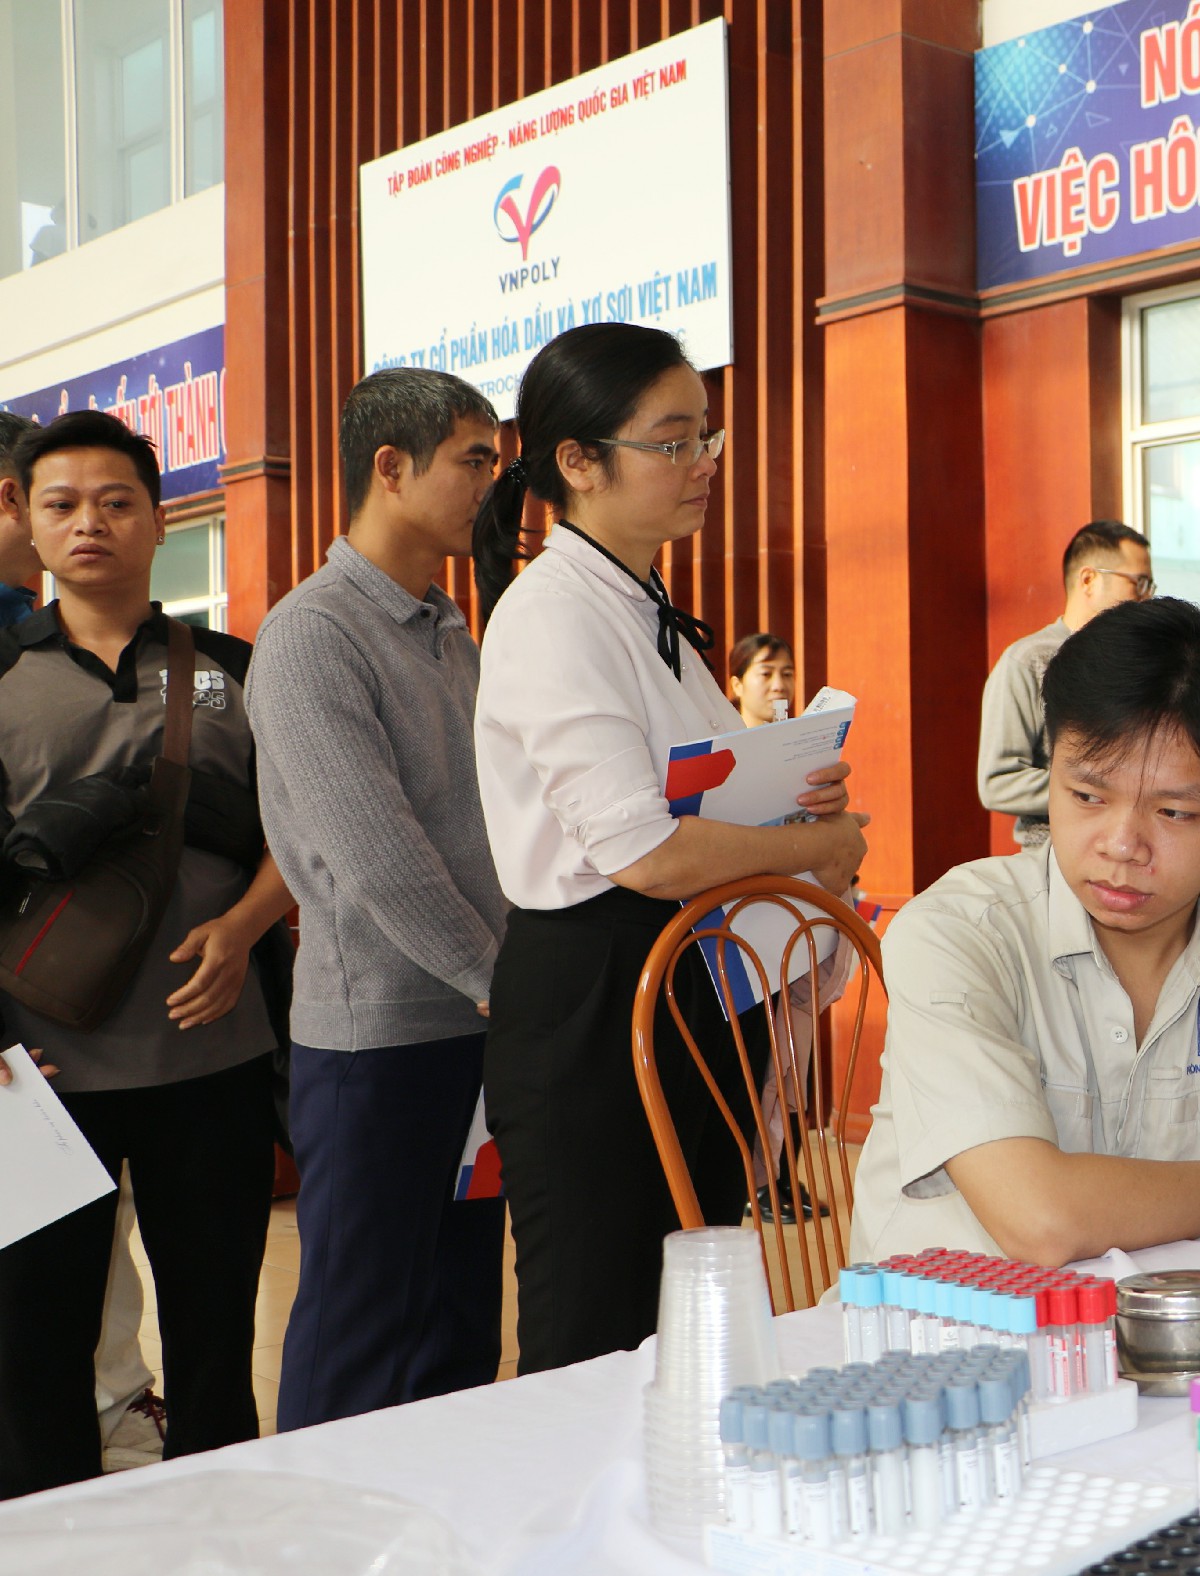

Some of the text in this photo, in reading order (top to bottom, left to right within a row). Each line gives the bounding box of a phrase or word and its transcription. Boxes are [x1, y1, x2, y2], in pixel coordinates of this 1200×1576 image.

[435, 151, 461, 177] CÔNG
[464, 133, 498, 166] NGHIỆP
[509, 121, 537, 148] NĂNG
[541, 105, 575, 135] LƯỢNG
[578, 86, 607, 122] QUỐC
[610, 83, 629, 108] GIA
[632, 69, 656, 100] VIỆT
[660, 58, 687, 90] NAM
[1015, 150, 1119, 254] VIỆC
[491, 316, 520, 360] HÓA
[638, 271, 671, 321] VIỆT
[677, 261, 717, 308] NAM
[499, 257, 560, 294] VNPOLY
[165, 361, 219, 472] THÀNH
